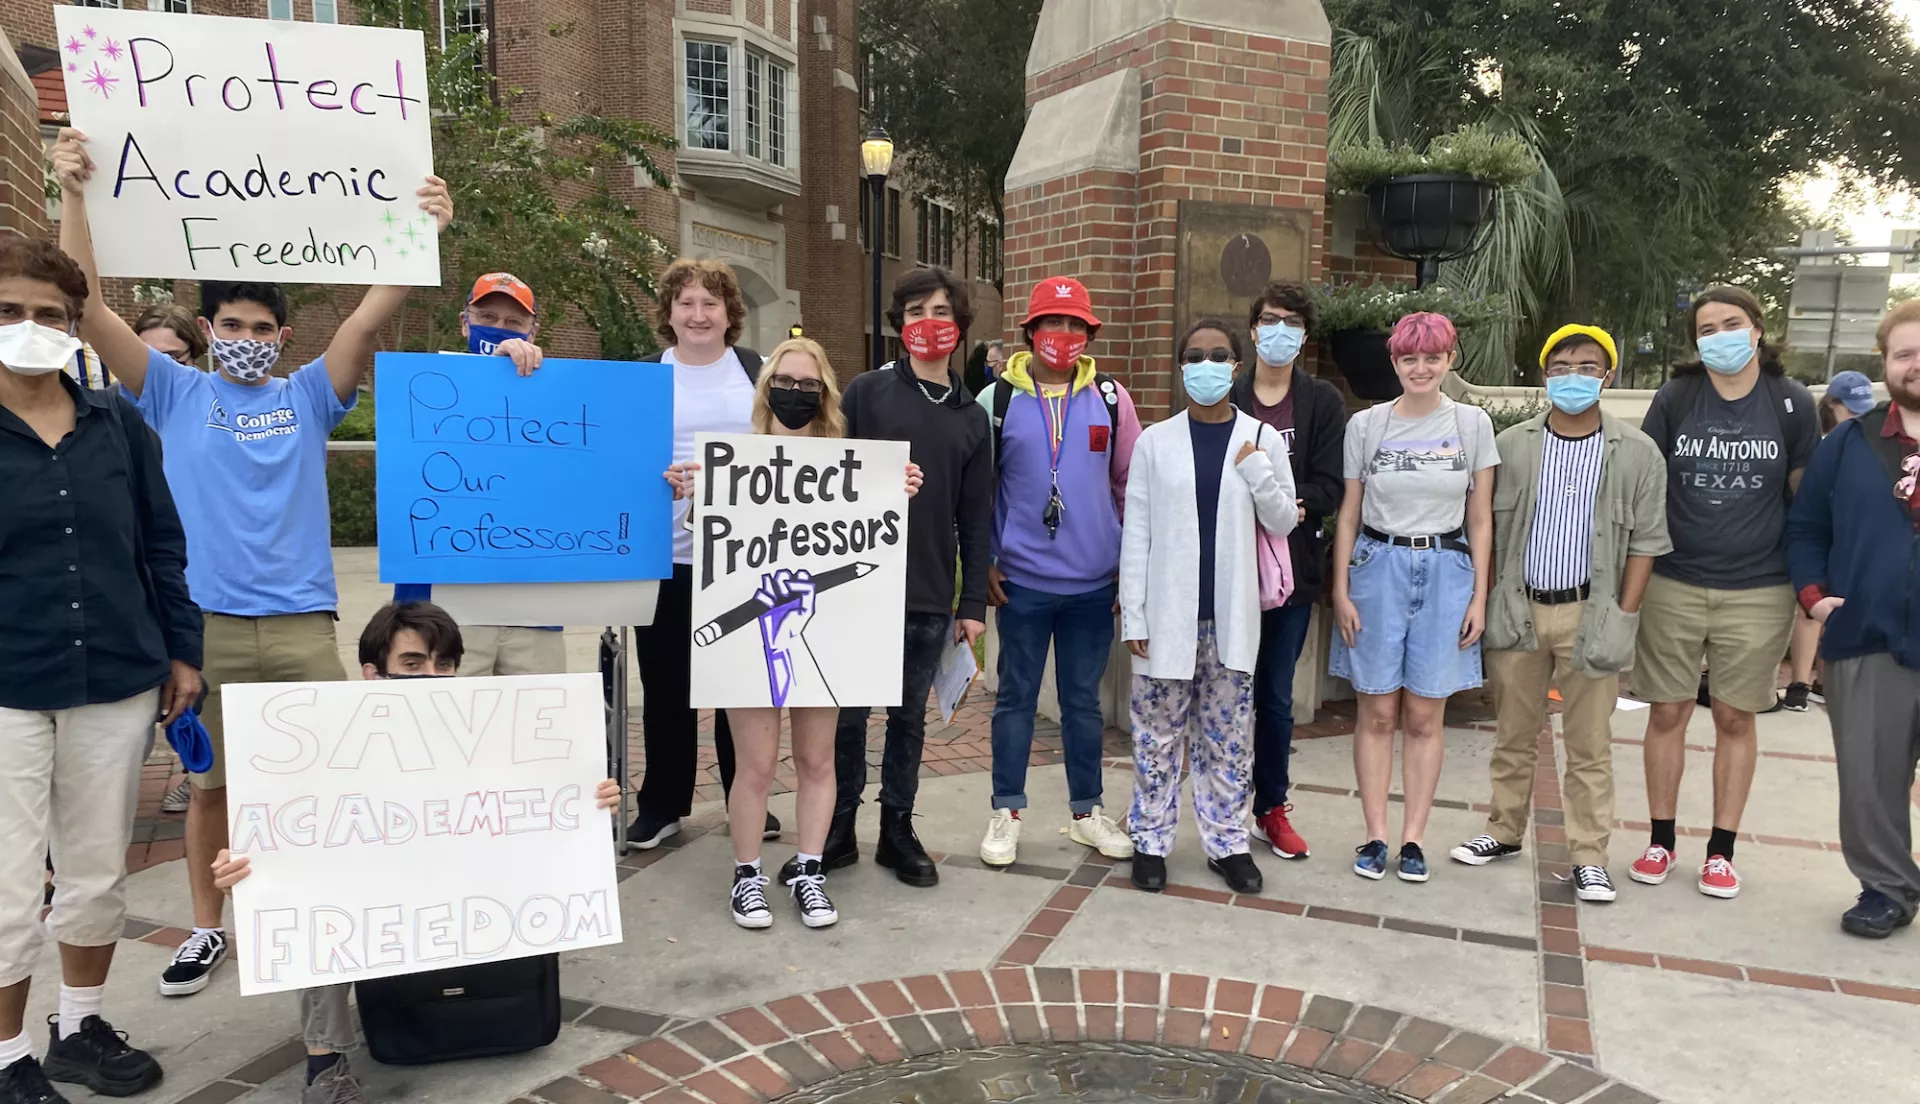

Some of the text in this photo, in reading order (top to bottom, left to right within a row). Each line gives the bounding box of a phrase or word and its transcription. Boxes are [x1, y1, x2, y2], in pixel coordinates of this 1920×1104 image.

[129, 37, 421, 121] Protect
[113, 131, 398, 201] Academic
[181, 217, 377, 270] Freedom
[480, 339, 499, 356] U
[235, 423, 299, 442] Democrat
[409, 371, 600, 446] Protect
[422, 451, 506, 493] Our
[703, 441, 862, 506] Protect
[1679, 471, 1764, 489] TEXAS
[1722, 462, 1750, 472] 1718
[409, 497, 631, 555] Professors!
[701, 510, 901, 591] Professors
[250, 688, 573, 775] SAVE
[231, 784, 582, 854] ACADEMIC
[253, 889, 612, 983] FREEDOM
